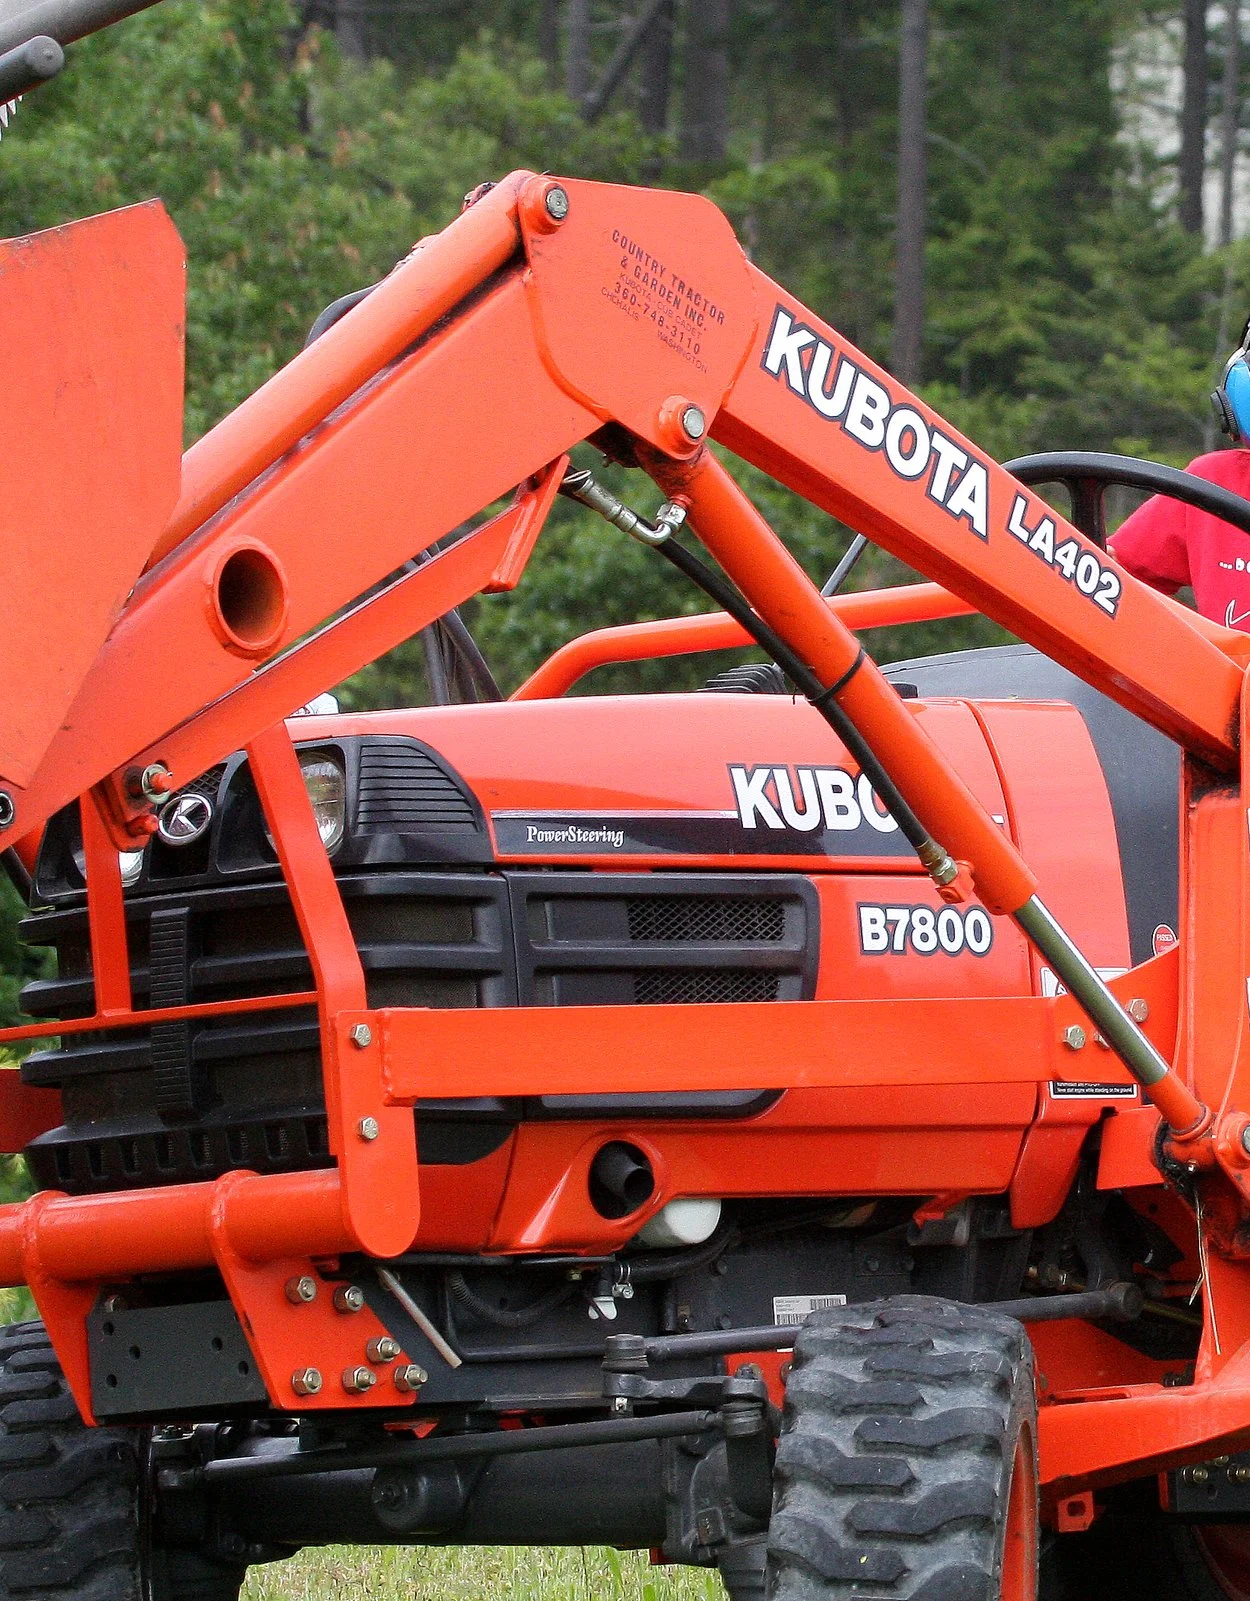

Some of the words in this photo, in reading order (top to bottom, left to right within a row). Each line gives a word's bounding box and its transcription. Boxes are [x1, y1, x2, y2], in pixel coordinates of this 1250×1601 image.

[612, 229, 666, 278] COUNTRY
[671, 273, 725, 325] TRACTOR
[620, 255, 628, 269] &
[634, 265, 681, 310] GARDEN
[685, 304, 707, 331] INC.
[614, 281, 700, 355] 360-748-3110
[762, 304, 989, 542] KUBOTA
[1006, 492, 1123, 618] LA402
[526, 825, 624, 848] PowerSteering
[858, 903, 994, 957] B7800
